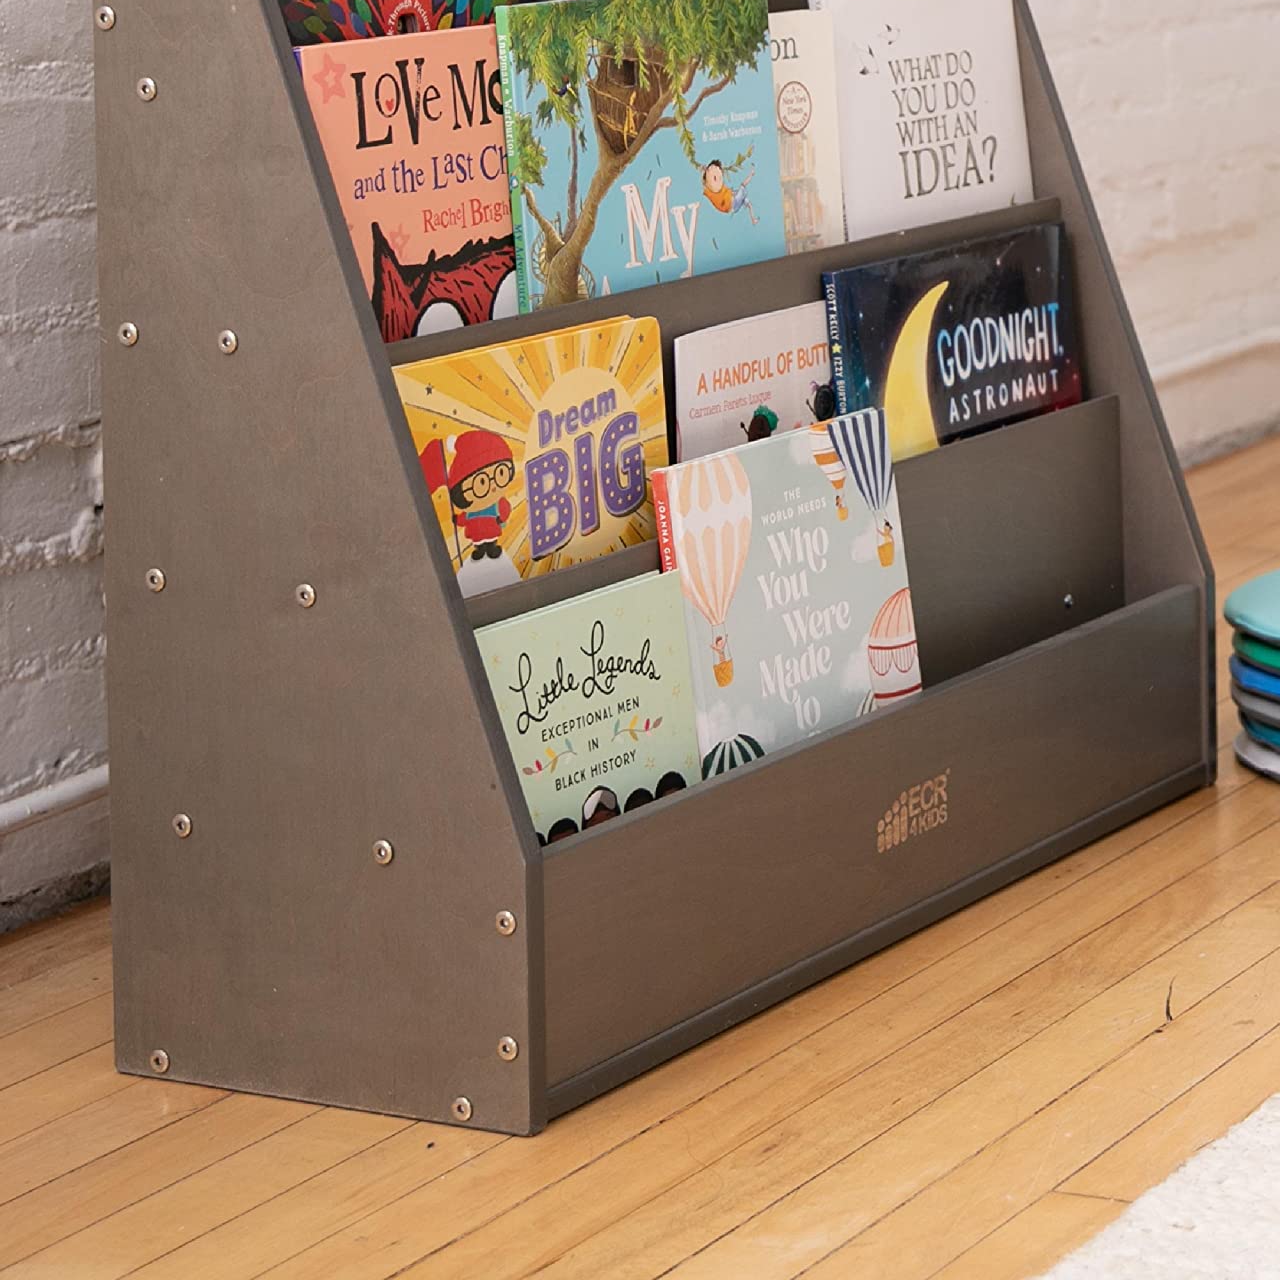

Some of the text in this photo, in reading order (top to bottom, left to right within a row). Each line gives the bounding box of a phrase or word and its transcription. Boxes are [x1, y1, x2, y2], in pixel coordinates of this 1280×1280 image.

[771, 37, 798, 61] on
[888, 50, 972, 84] WHAT DO
[892, 78, 976, 118] YOU DO
[504, 98, 514, 156] Warburton
[896, 110, 978, 147] WITH AN
[354, 168, 386, 200] and
[392, 159, 424, 194] the
[432, 153, 475, 191] Last
[898, 135, 998, 199] IDEA?
[422, 198, 510, 233] Rachel Brigh
[621, 176, 700, 278] My
[826, 284, 840, 340] SCOTT KELLY
[697, 342, 828, 396] A HANDFUL OF BUTT
[834, 356, 843, 378] IZZY
[538, 388, 617, 448] Dream
[689, 404, 722, 420] Carmen
[950, 369, 1058, 424] ASTRONAUT
[525, 412, 646, 561] BIG
[784, 487, 800, 502] THE
[658, 500, 670, 544] JOANNA
[760, 497, 826, 526] WORLD NEEDS
[766, 526, 829, 573] Who
[757, 569, 809, 610] You
[782, 600, 851, 648] Were
[509, 620, 661, 734] Little Legends
[760, 643, 832, 704] Made
[541, 696, 640, 742] EXCEPTIONAL MEN
[588, 738, 599, 752] IN
[555, 749, 637, 792] BLACK HISTORY
[908, 774, 948, 817] ECR
